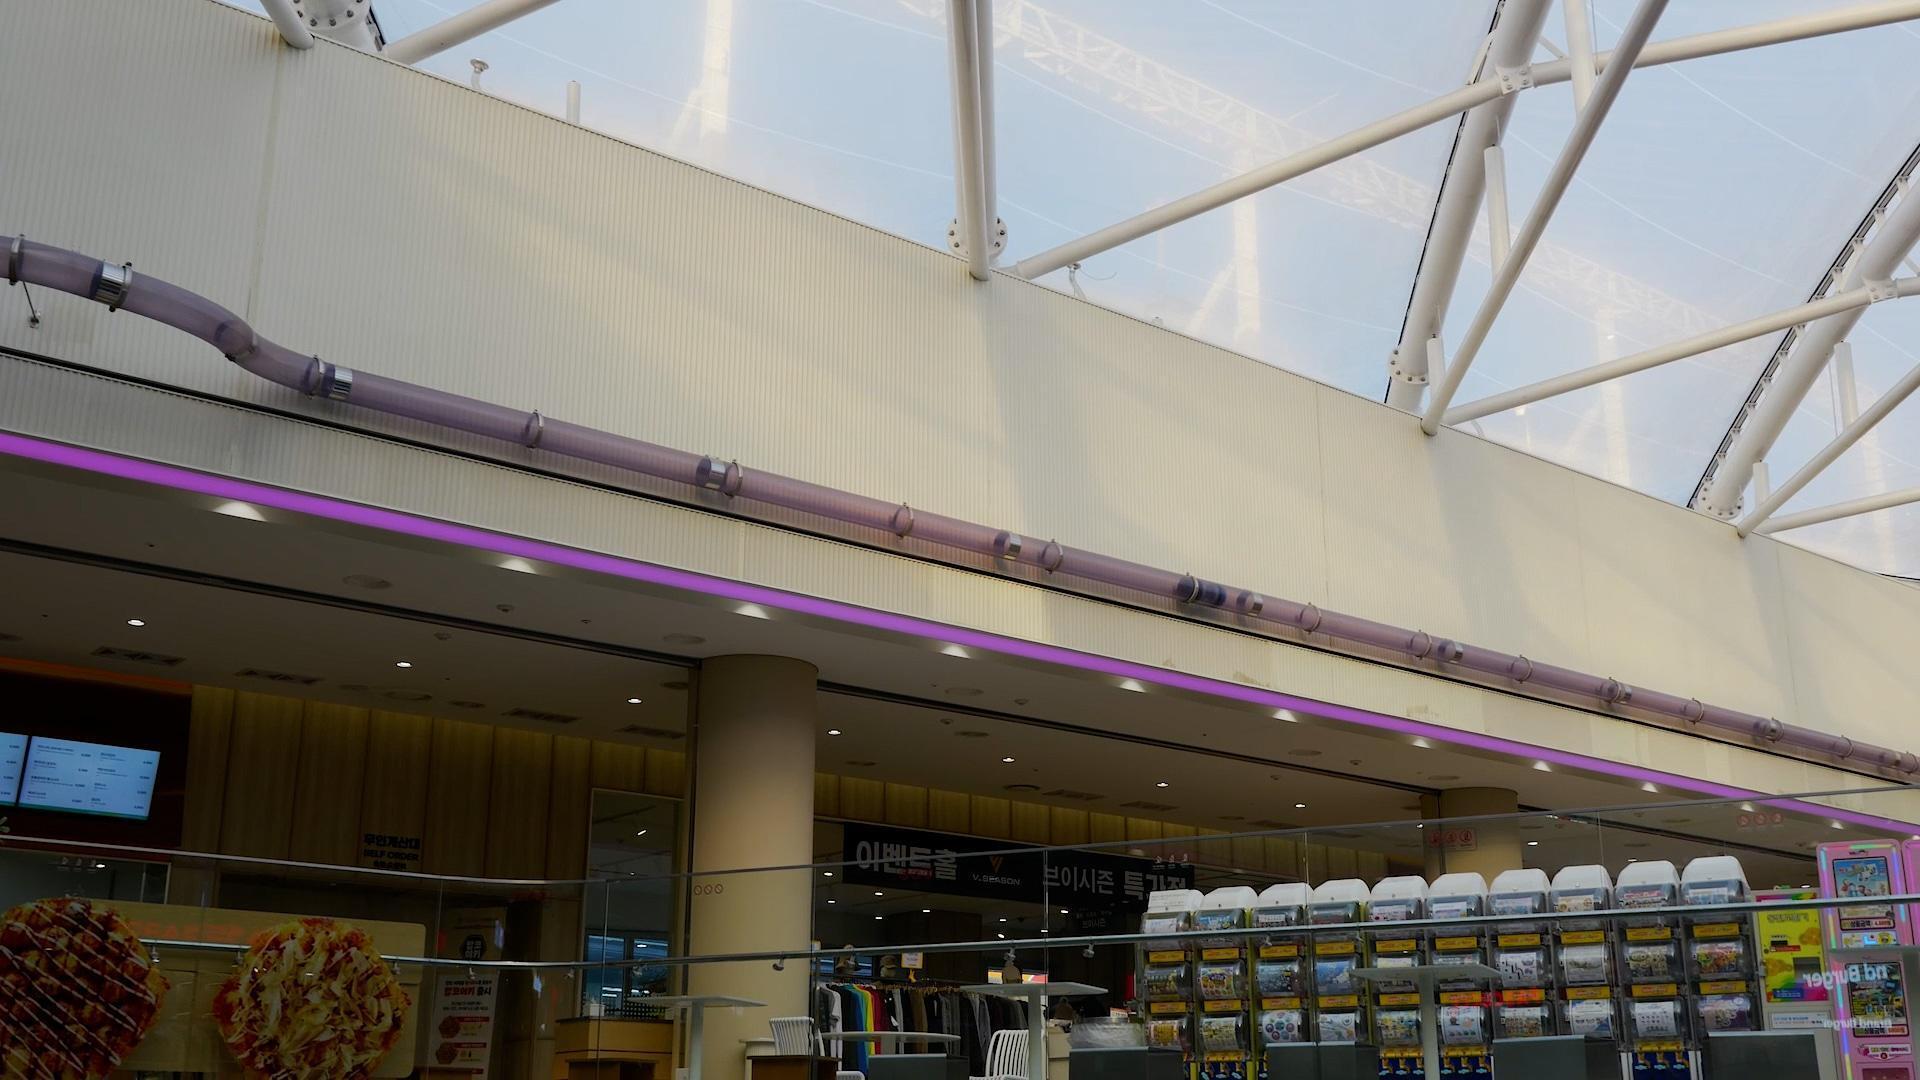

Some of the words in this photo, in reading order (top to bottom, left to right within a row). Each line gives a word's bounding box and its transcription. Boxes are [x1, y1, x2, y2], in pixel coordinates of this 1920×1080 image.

[387, 851, 420, 861] ORDER
[856, 840, 958, 881] 이벤트홀
[971, 873, 1022, 887] V.SEASON
[1043, 864, 1115, 896] 브이시즌
